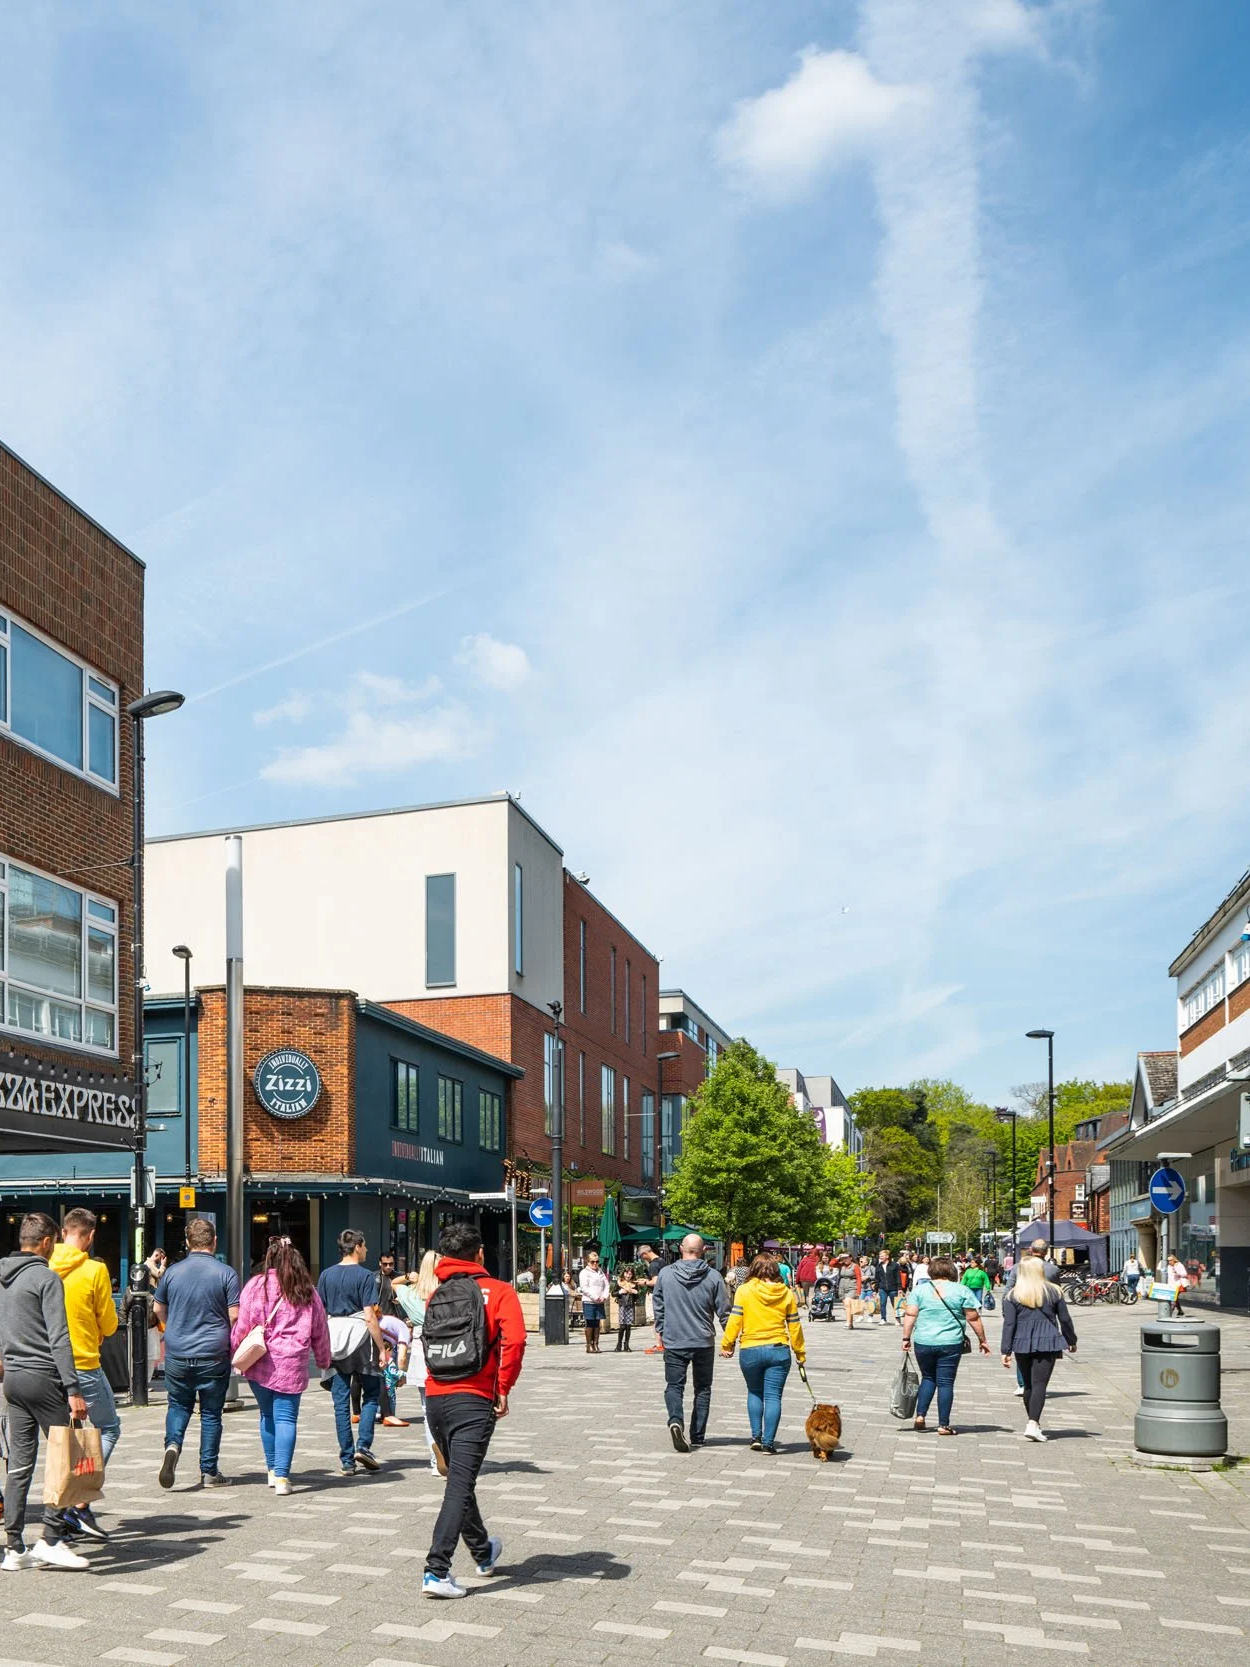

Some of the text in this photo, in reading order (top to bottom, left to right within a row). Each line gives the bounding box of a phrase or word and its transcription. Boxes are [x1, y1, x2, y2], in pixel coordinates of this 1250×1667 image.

[268, 1054, 309, 1070] INDIVIDUALLY
[264, 1074, 312, 1092] Zizzi
[269, 1098, 308, 1113] ITALIAN
[420, 1146, 444, 1166] ITALIAN
[428, 1341, 467, 1358] FILA
